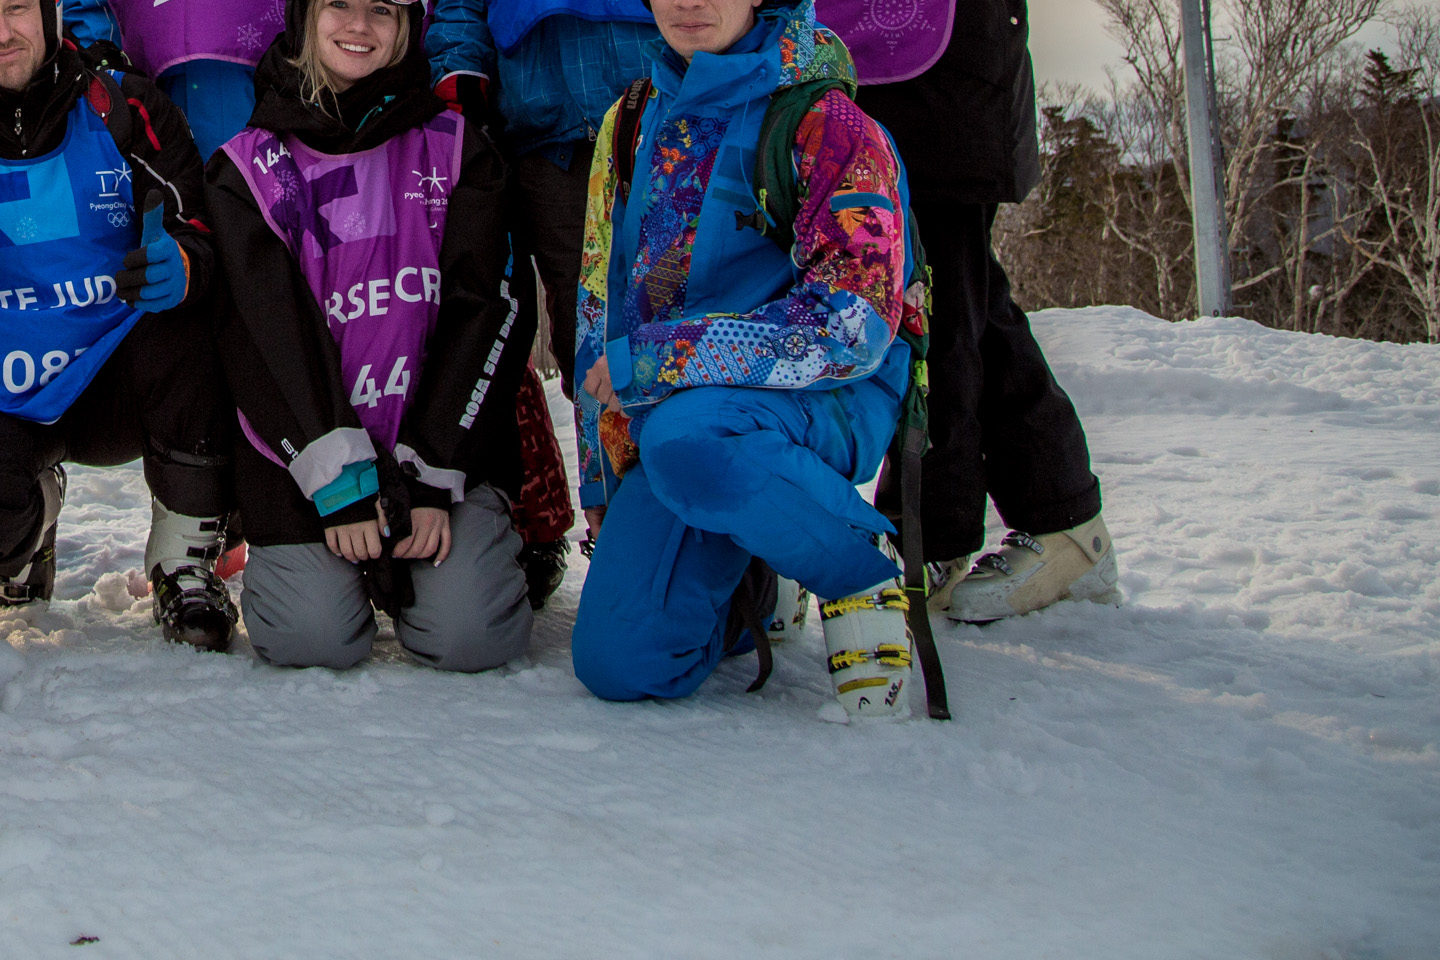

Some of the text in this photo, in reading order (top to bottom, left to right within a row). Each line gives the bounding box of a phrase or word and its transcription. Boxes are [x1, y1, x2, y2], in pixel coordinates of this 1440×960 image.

[626, 78, 644, 110] anon
[253, 141, 292, 175] 144
[49, 274, 118, 308] JUD
[325, 266, 442, 328] RSE CR
[2, 347, 90, 395] 08
[349, 355, 411, 409] 44
[458, 377, 491, 430] ROSA
